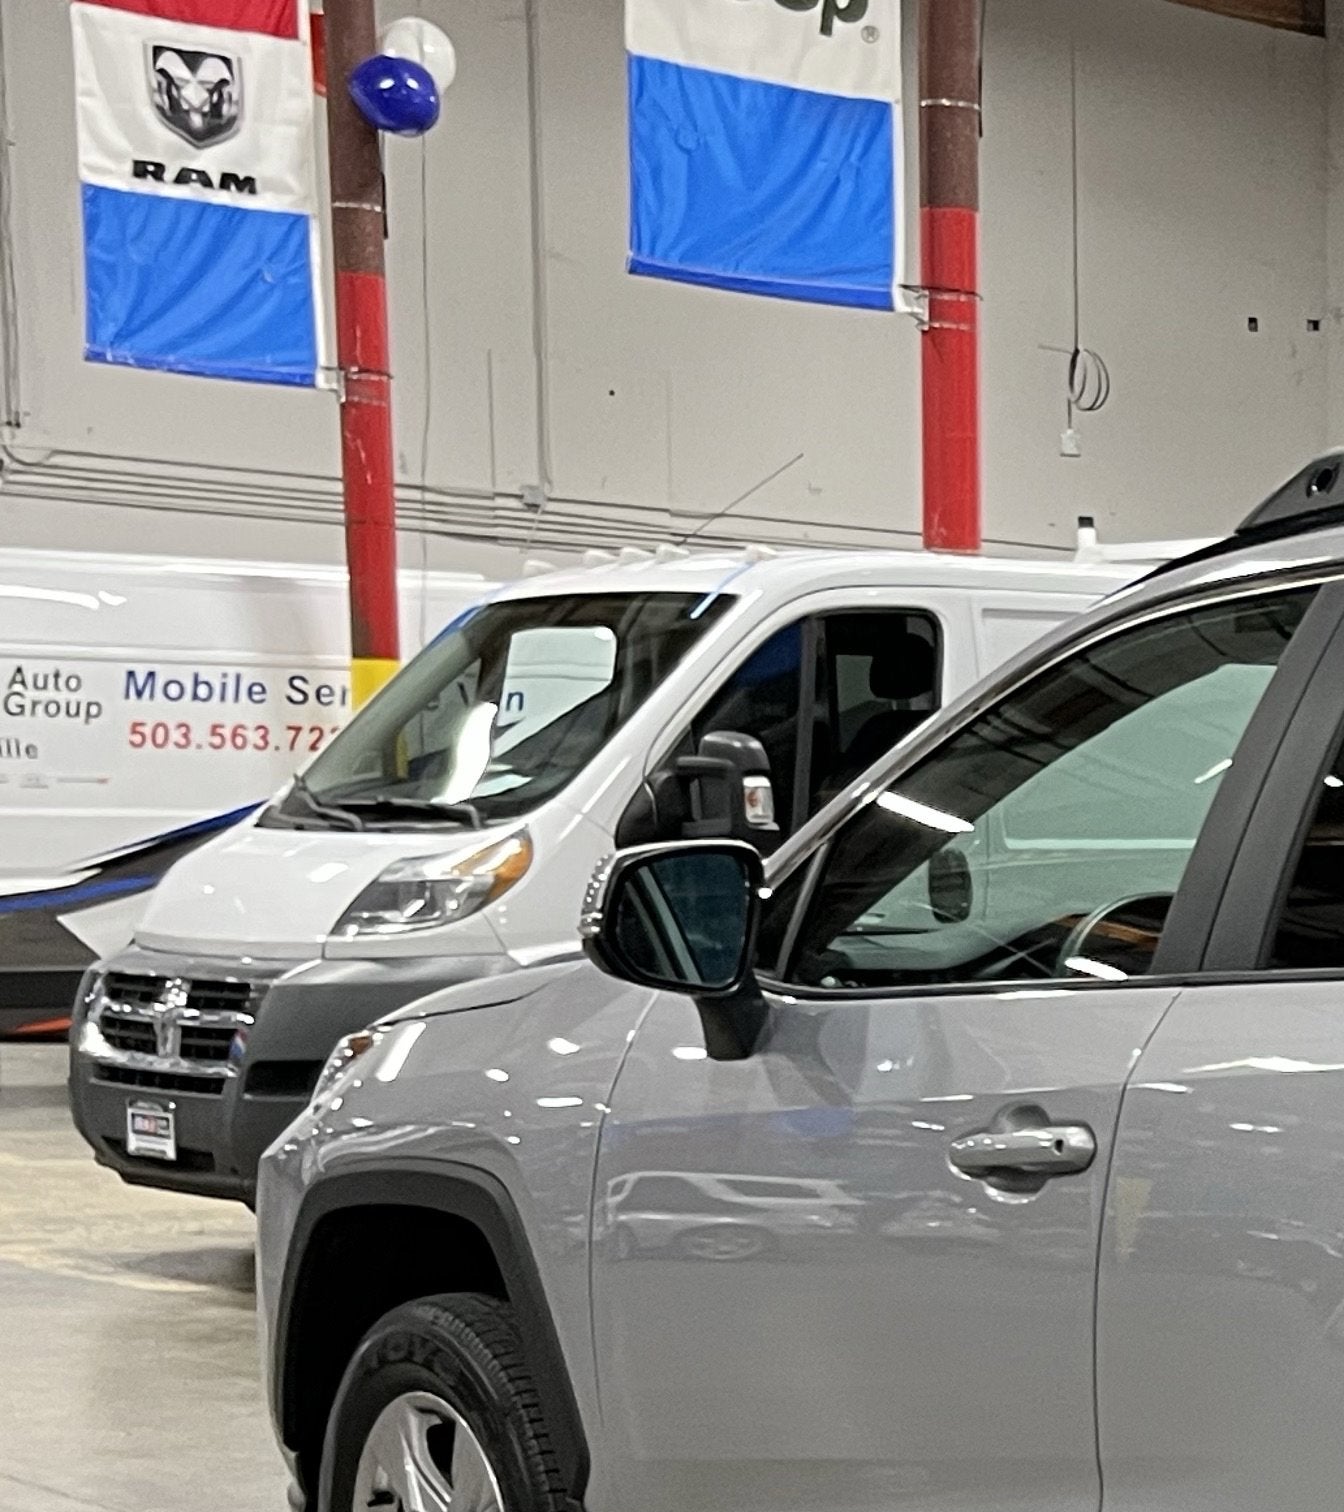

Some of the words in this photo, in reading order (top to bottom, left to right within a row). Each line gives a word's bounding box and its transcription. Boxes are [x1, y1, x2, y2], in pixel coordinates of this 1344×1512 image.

[131, 158, 258, 196] RAM
[7, 664, 83, 692] Auto
[124, 670, 268, 704] Mobile
[3, 691, 103, 725] Group
[128, 721, 339, 752] 503.563.72
